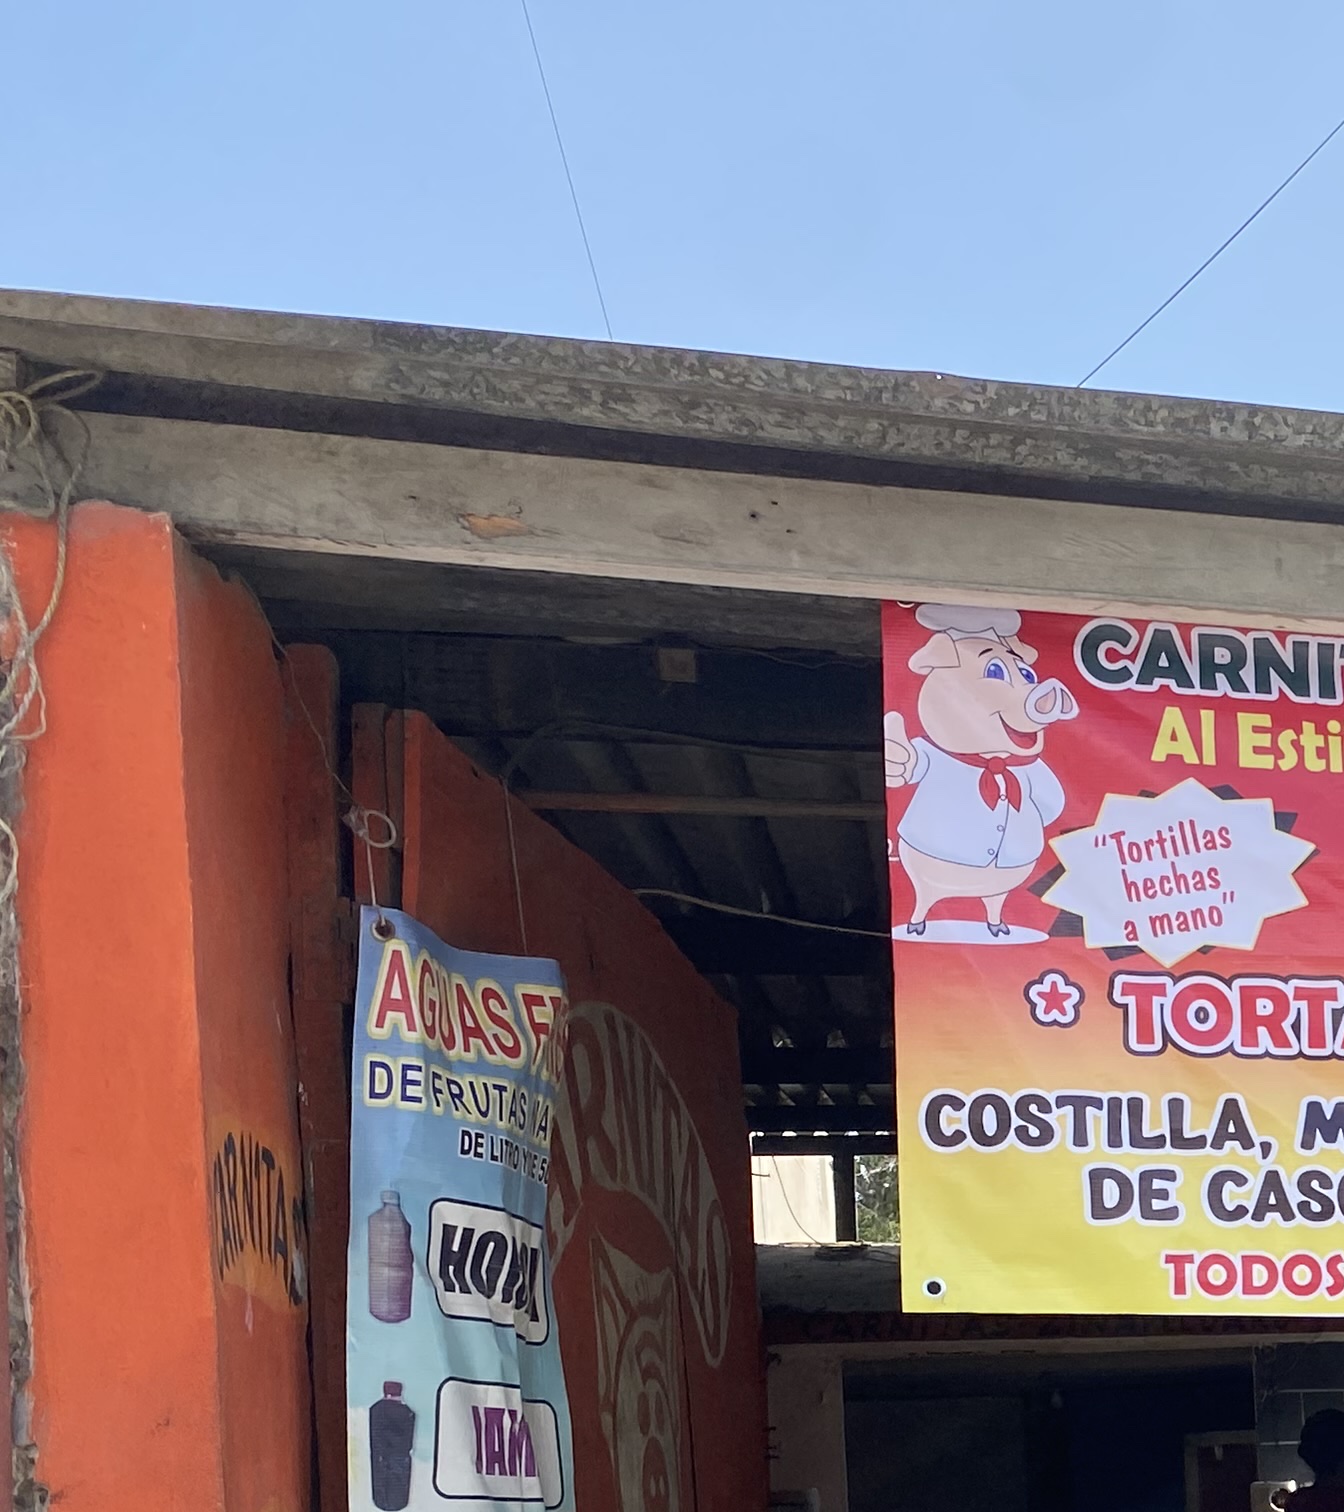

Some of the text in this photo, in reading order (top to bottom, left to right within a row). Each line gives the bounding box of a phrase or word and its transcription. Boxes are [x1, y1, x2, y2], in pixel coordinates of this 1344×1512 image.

[1151, 707, 1216, 765] Al
[1121, 865, 1221, 903] hechas
[1123, 920, 1138, 942] a
[374, 948, 522, 1060] AGUAS
[368, 1060, 424, 1104] DE
[432, 1068, 528, 1132] FRUTAS
[459, 1129, 486, 1160] DE
[922, 1092, 1275, 1161] COSTILLA,
[1085, 1168, 1180, 1223] DE
